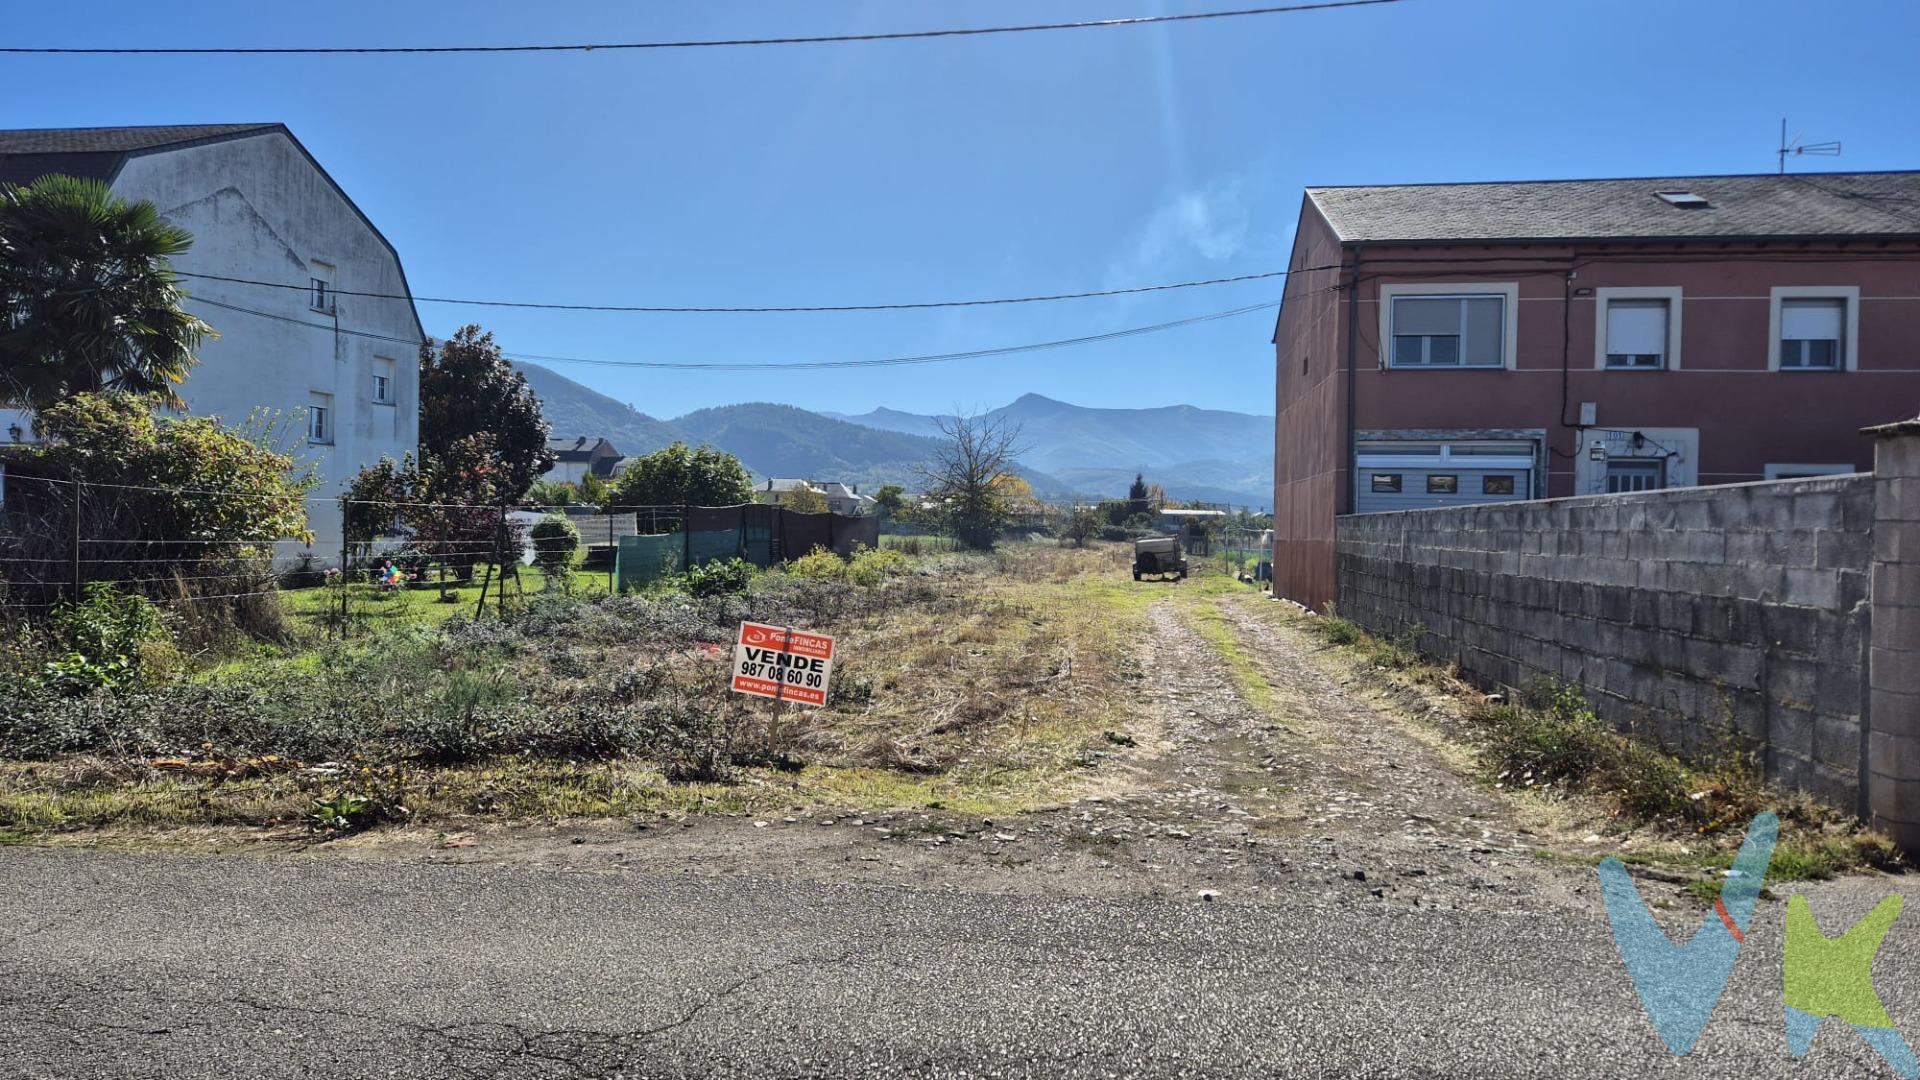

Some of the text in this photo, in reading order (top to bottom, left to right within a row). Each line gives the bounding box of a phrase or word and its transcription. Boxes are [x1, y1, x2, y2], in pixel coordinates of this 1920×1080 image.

[745, 647, 824, 673] VENDE
[741, 661, 822, 688] 987 08 60 90
